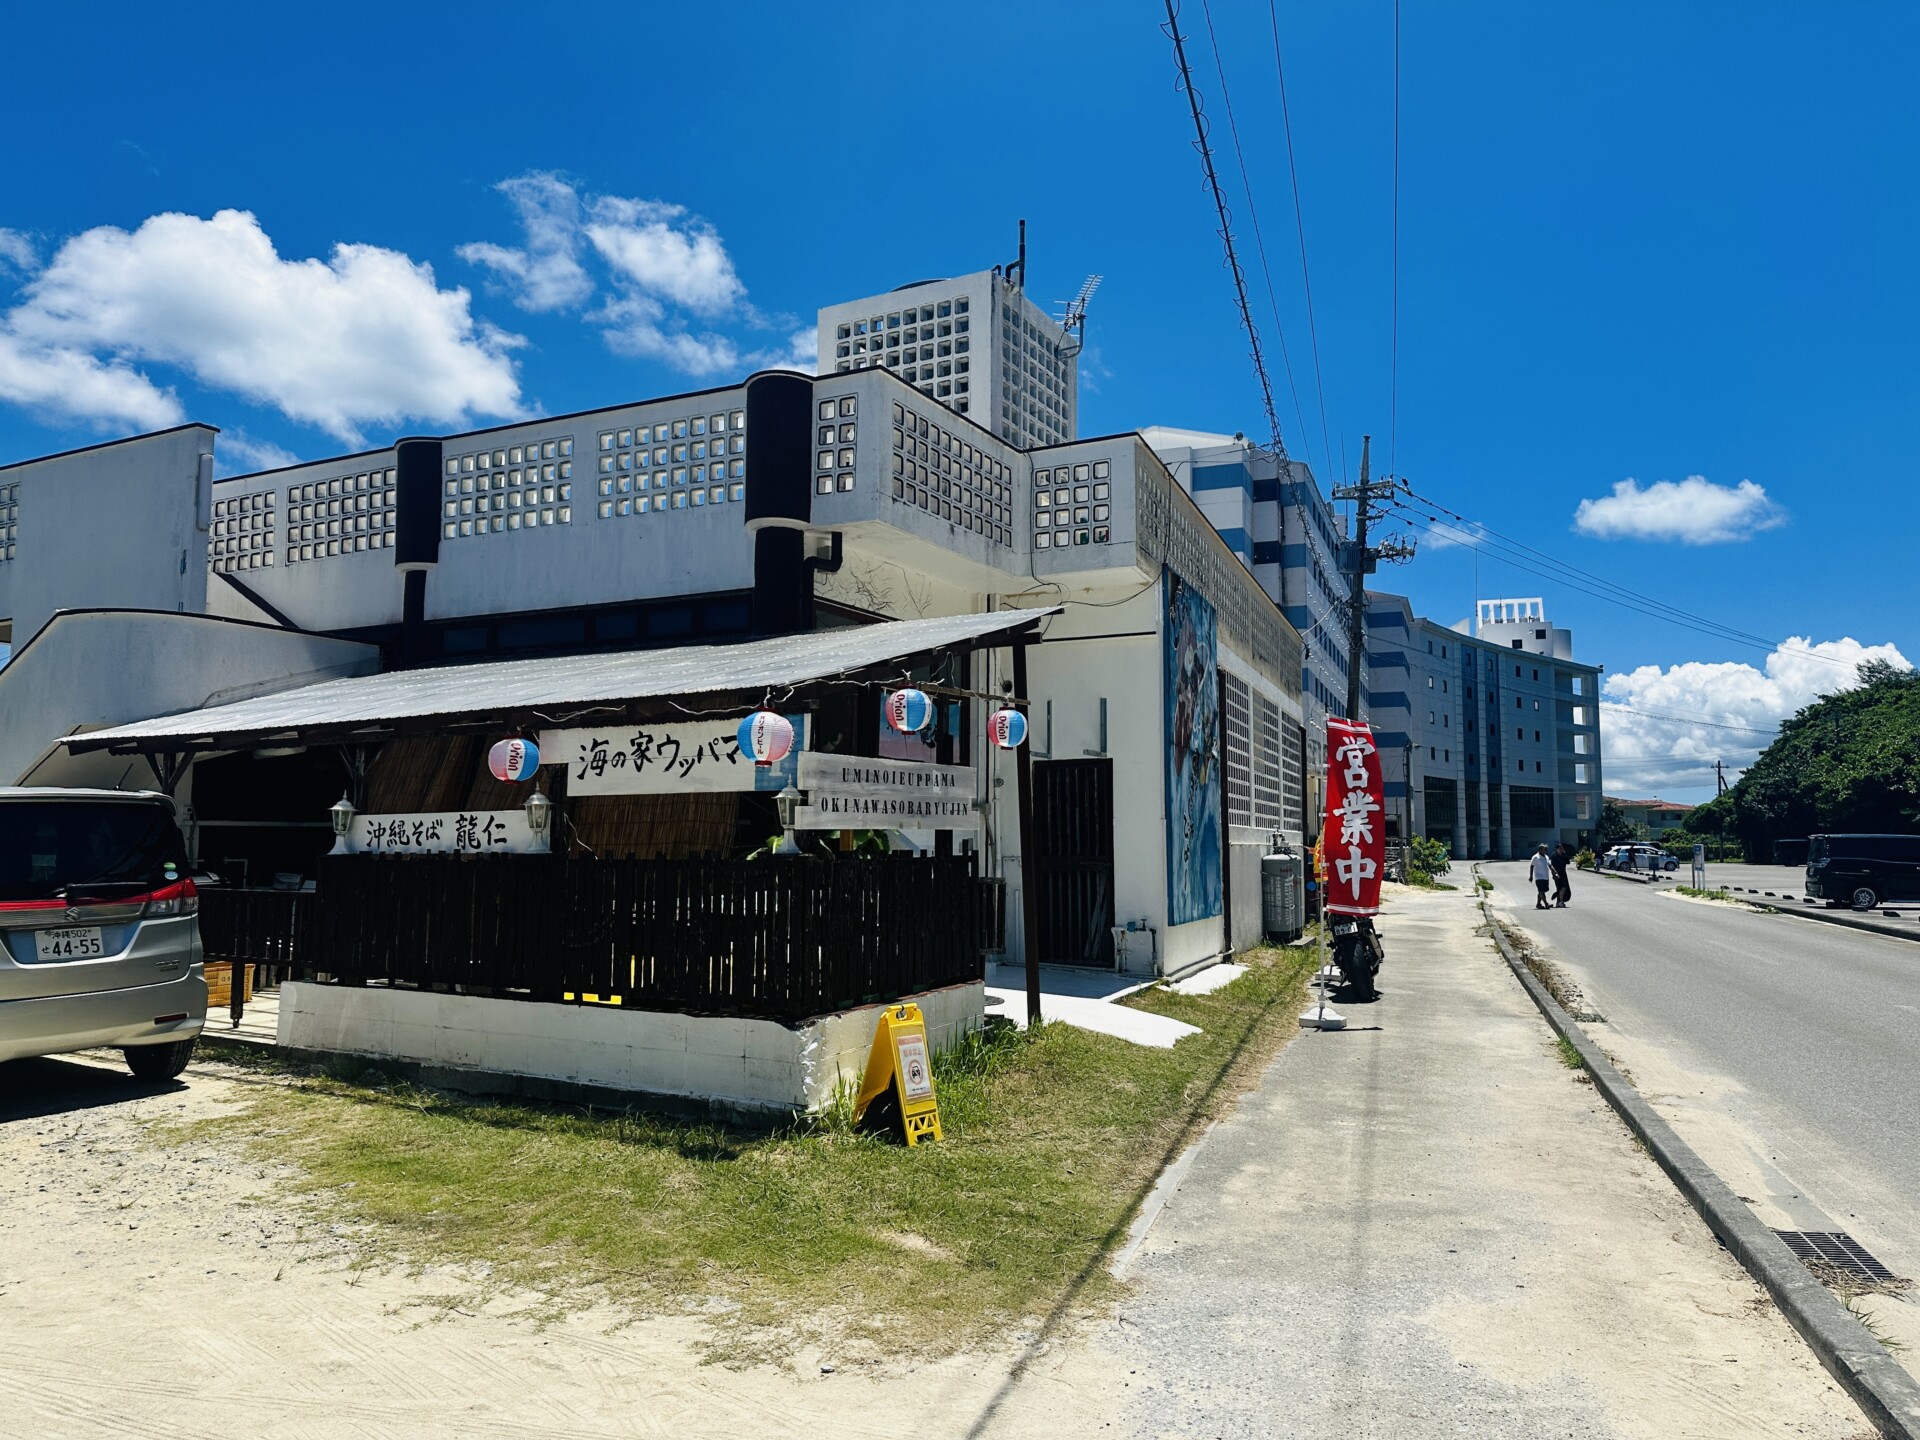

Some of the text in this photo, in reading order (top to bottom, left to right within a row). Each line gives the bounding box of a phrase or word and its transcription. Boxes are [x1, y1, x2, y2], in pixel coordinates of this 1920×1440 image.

[894, 693, 907, 722] Orion
[998, 715, 1009, 740] Orion
[507, 742, 523, 771] Orion
[842, 767, 956, 787] UMINOIEUPPAMA
[821, 796, 969, 816] OKINAWASOBARYUJIN
[1333, 735, 1381, 901] 営業中
[366, 813, 508, 850] 沖縄そば 龍仁
[52, 938, 100, 957] 44-55
